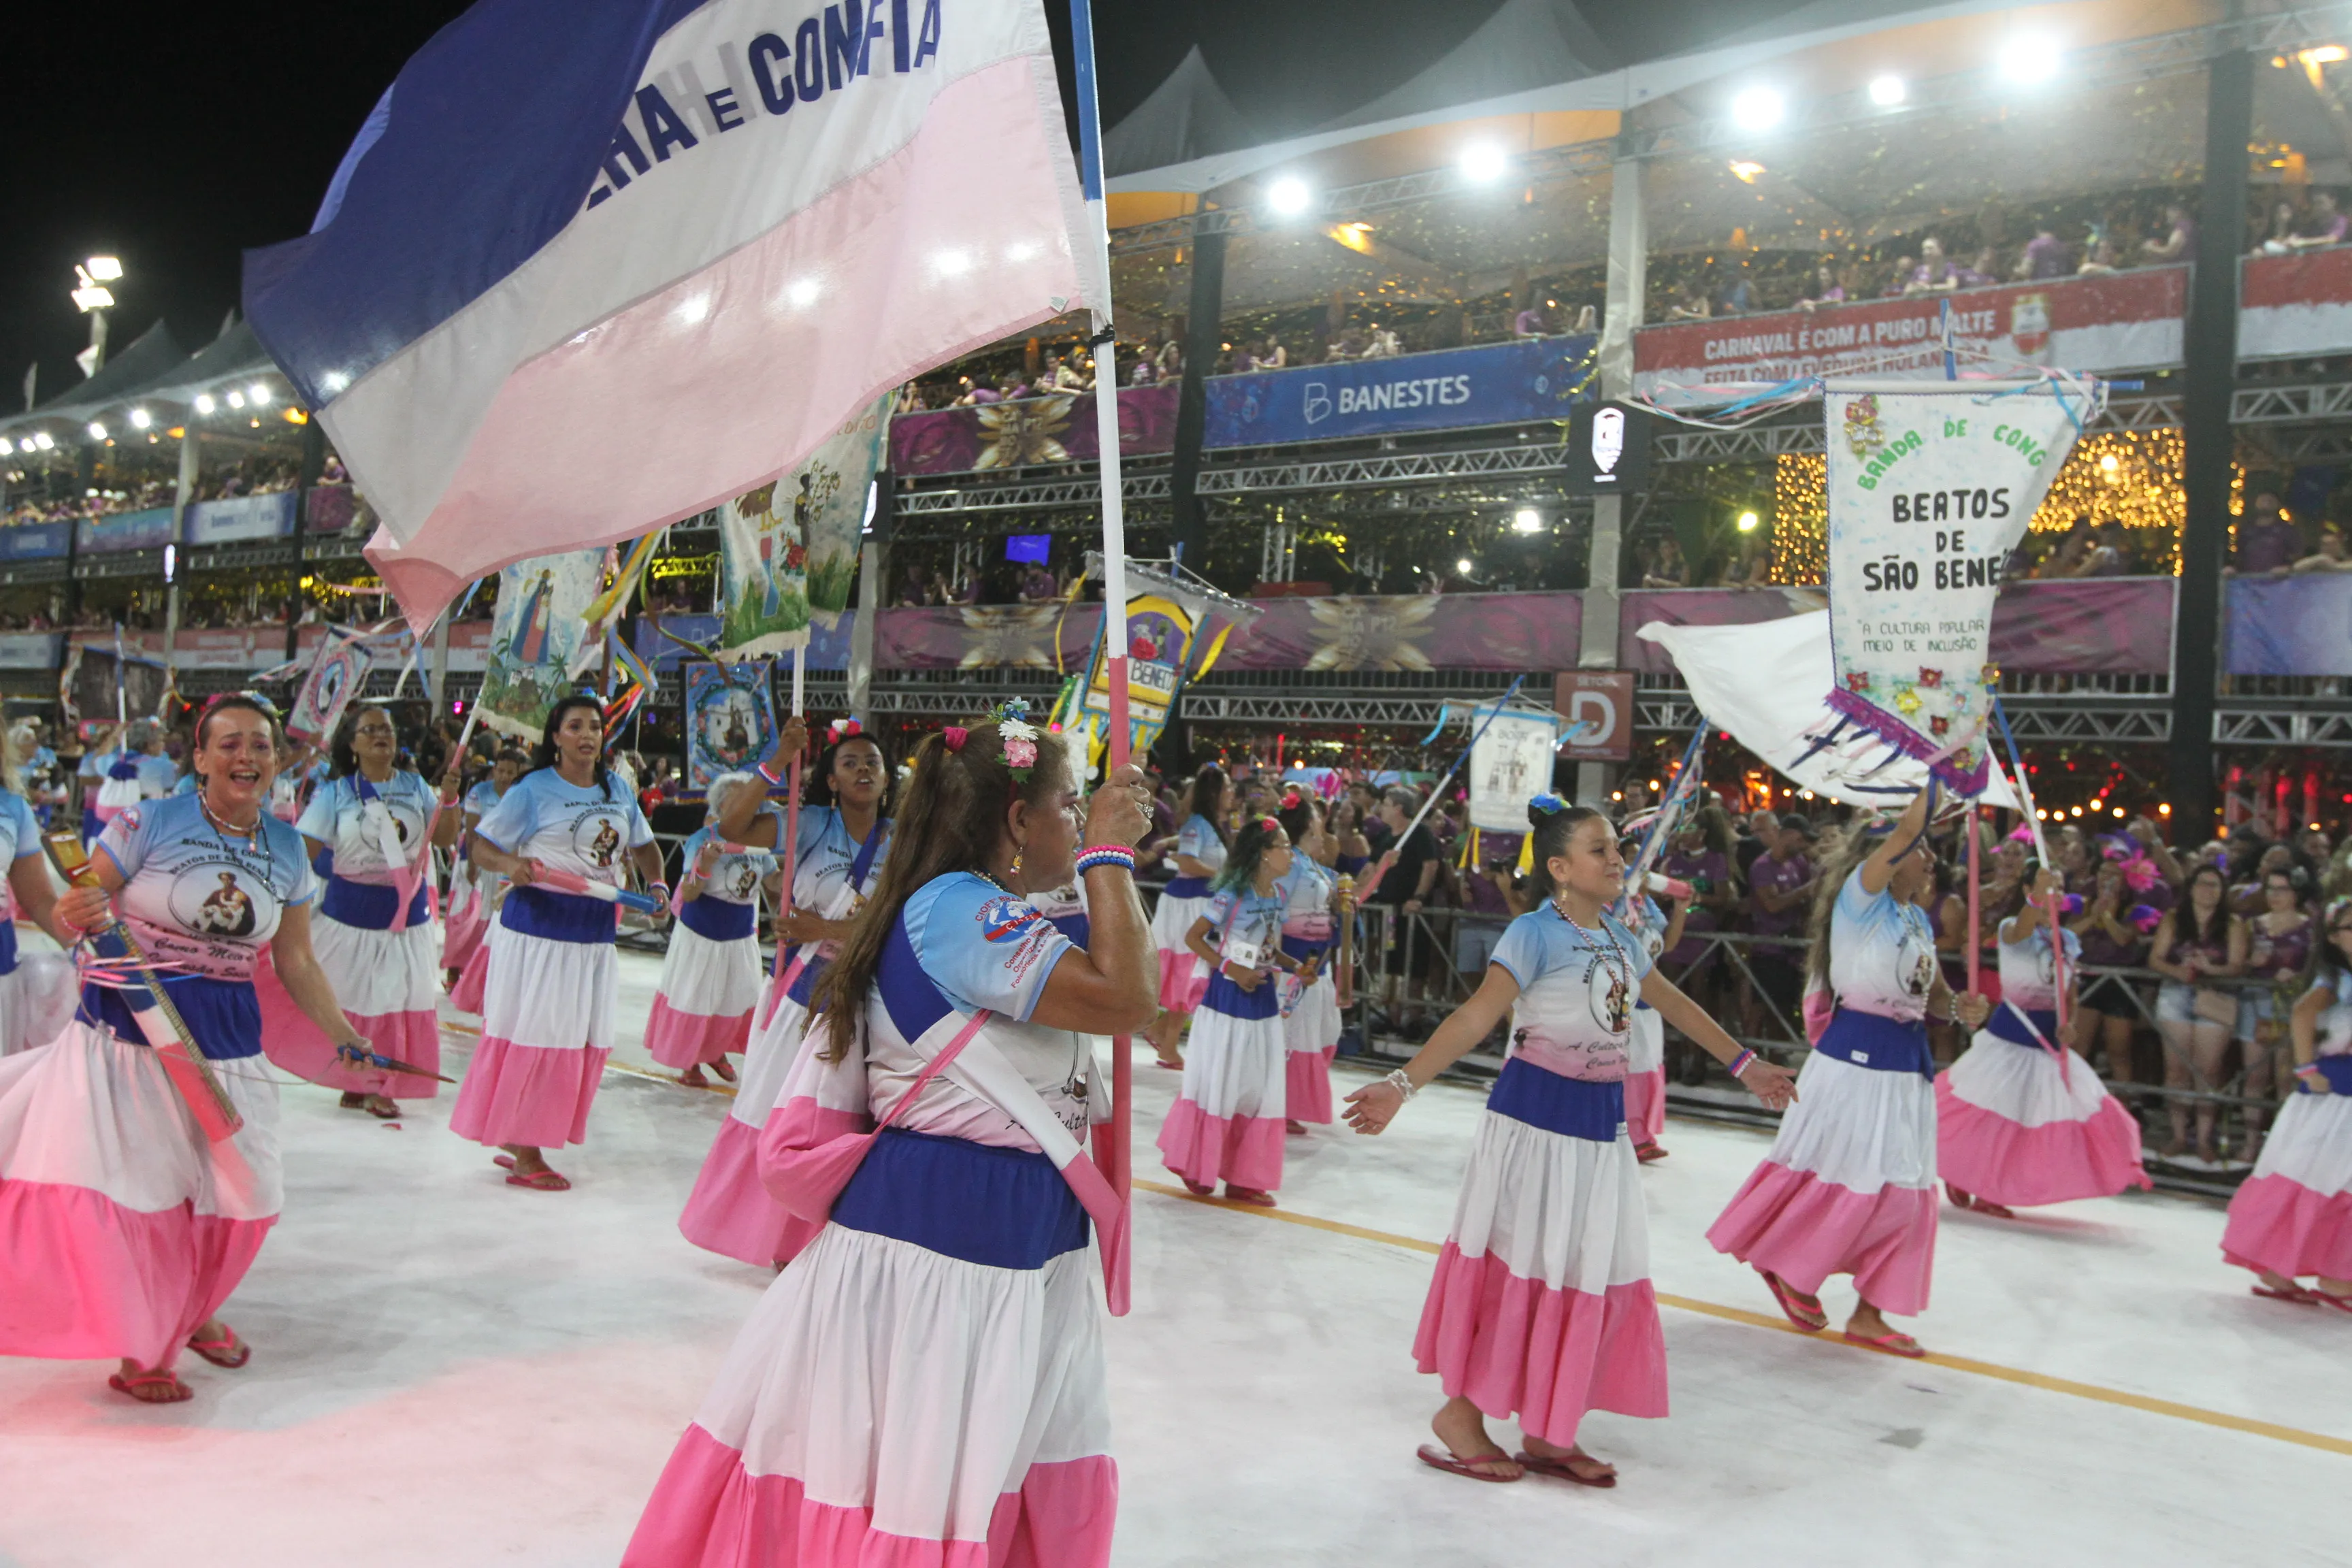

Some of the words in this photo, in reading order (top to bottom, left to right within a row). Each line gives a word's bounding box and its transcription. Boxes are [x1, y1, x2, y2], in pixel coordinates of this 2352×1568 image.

[705, 86, 746, 133] E
[748, 0, 941, 116] CONFIA
[1705, 332, 1795, 361] CARNAVAL
[1812, 325, 1856, 350] COM
[1858, 323, 1872, 344] A
[1874, 316, 1927, 342] PURO
[1881, 345, 1989, 372] HOLANESA
[1338, 374, 1470, 414] BANESTES
[1857, 429, 1923, 491] BANDA
[1943, 418, 1968, 439] DE
[1892, 487, 2010, 523] BEATOS
[1936, 529, 1965, 553] DE
[1862, 553, 1919, 591] SÃO
[1935, 551, 2009, 591] BENE
[1863, 639, 1894, 653] MEIO
[1903, 638, 1917, 653] DE
[1880, 621, 1931, 636] CULTURA
[1938, 619, 1986, 635] POPULAR
[1571, 690, 1616, 747] D
[974, 897, 997, 922] CIOFF
[1004, 936, 1032, 969] Conselho
